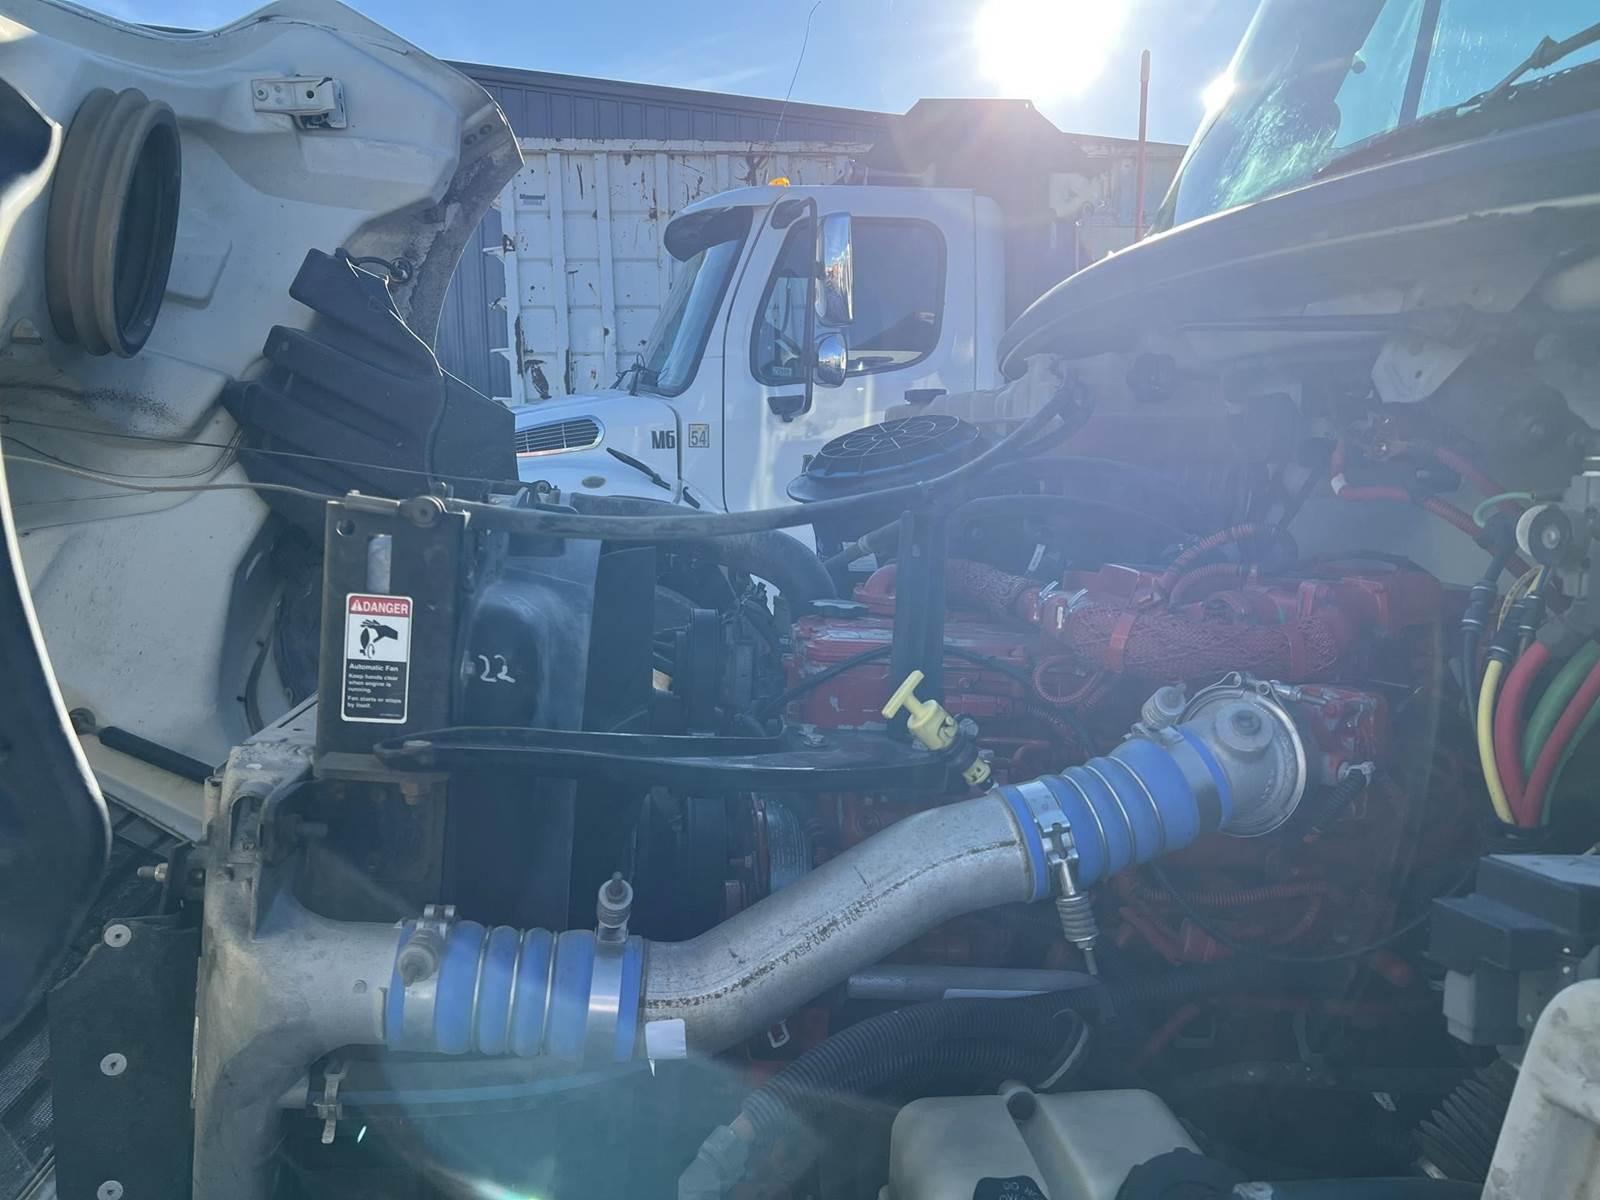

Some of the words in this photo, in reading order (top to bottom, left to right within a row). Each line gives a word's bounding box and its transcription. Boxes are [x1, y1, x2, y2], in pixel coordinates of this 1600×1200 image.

[651, 430, 676, 449] M6
[691, 430, 707, 446] 54
[363, 601, 409, 615] DANGER
[348, 663, 384, 671] Automatic
[385, 664, 399, 672] Fan
[478, 654, 516, 683] 22
